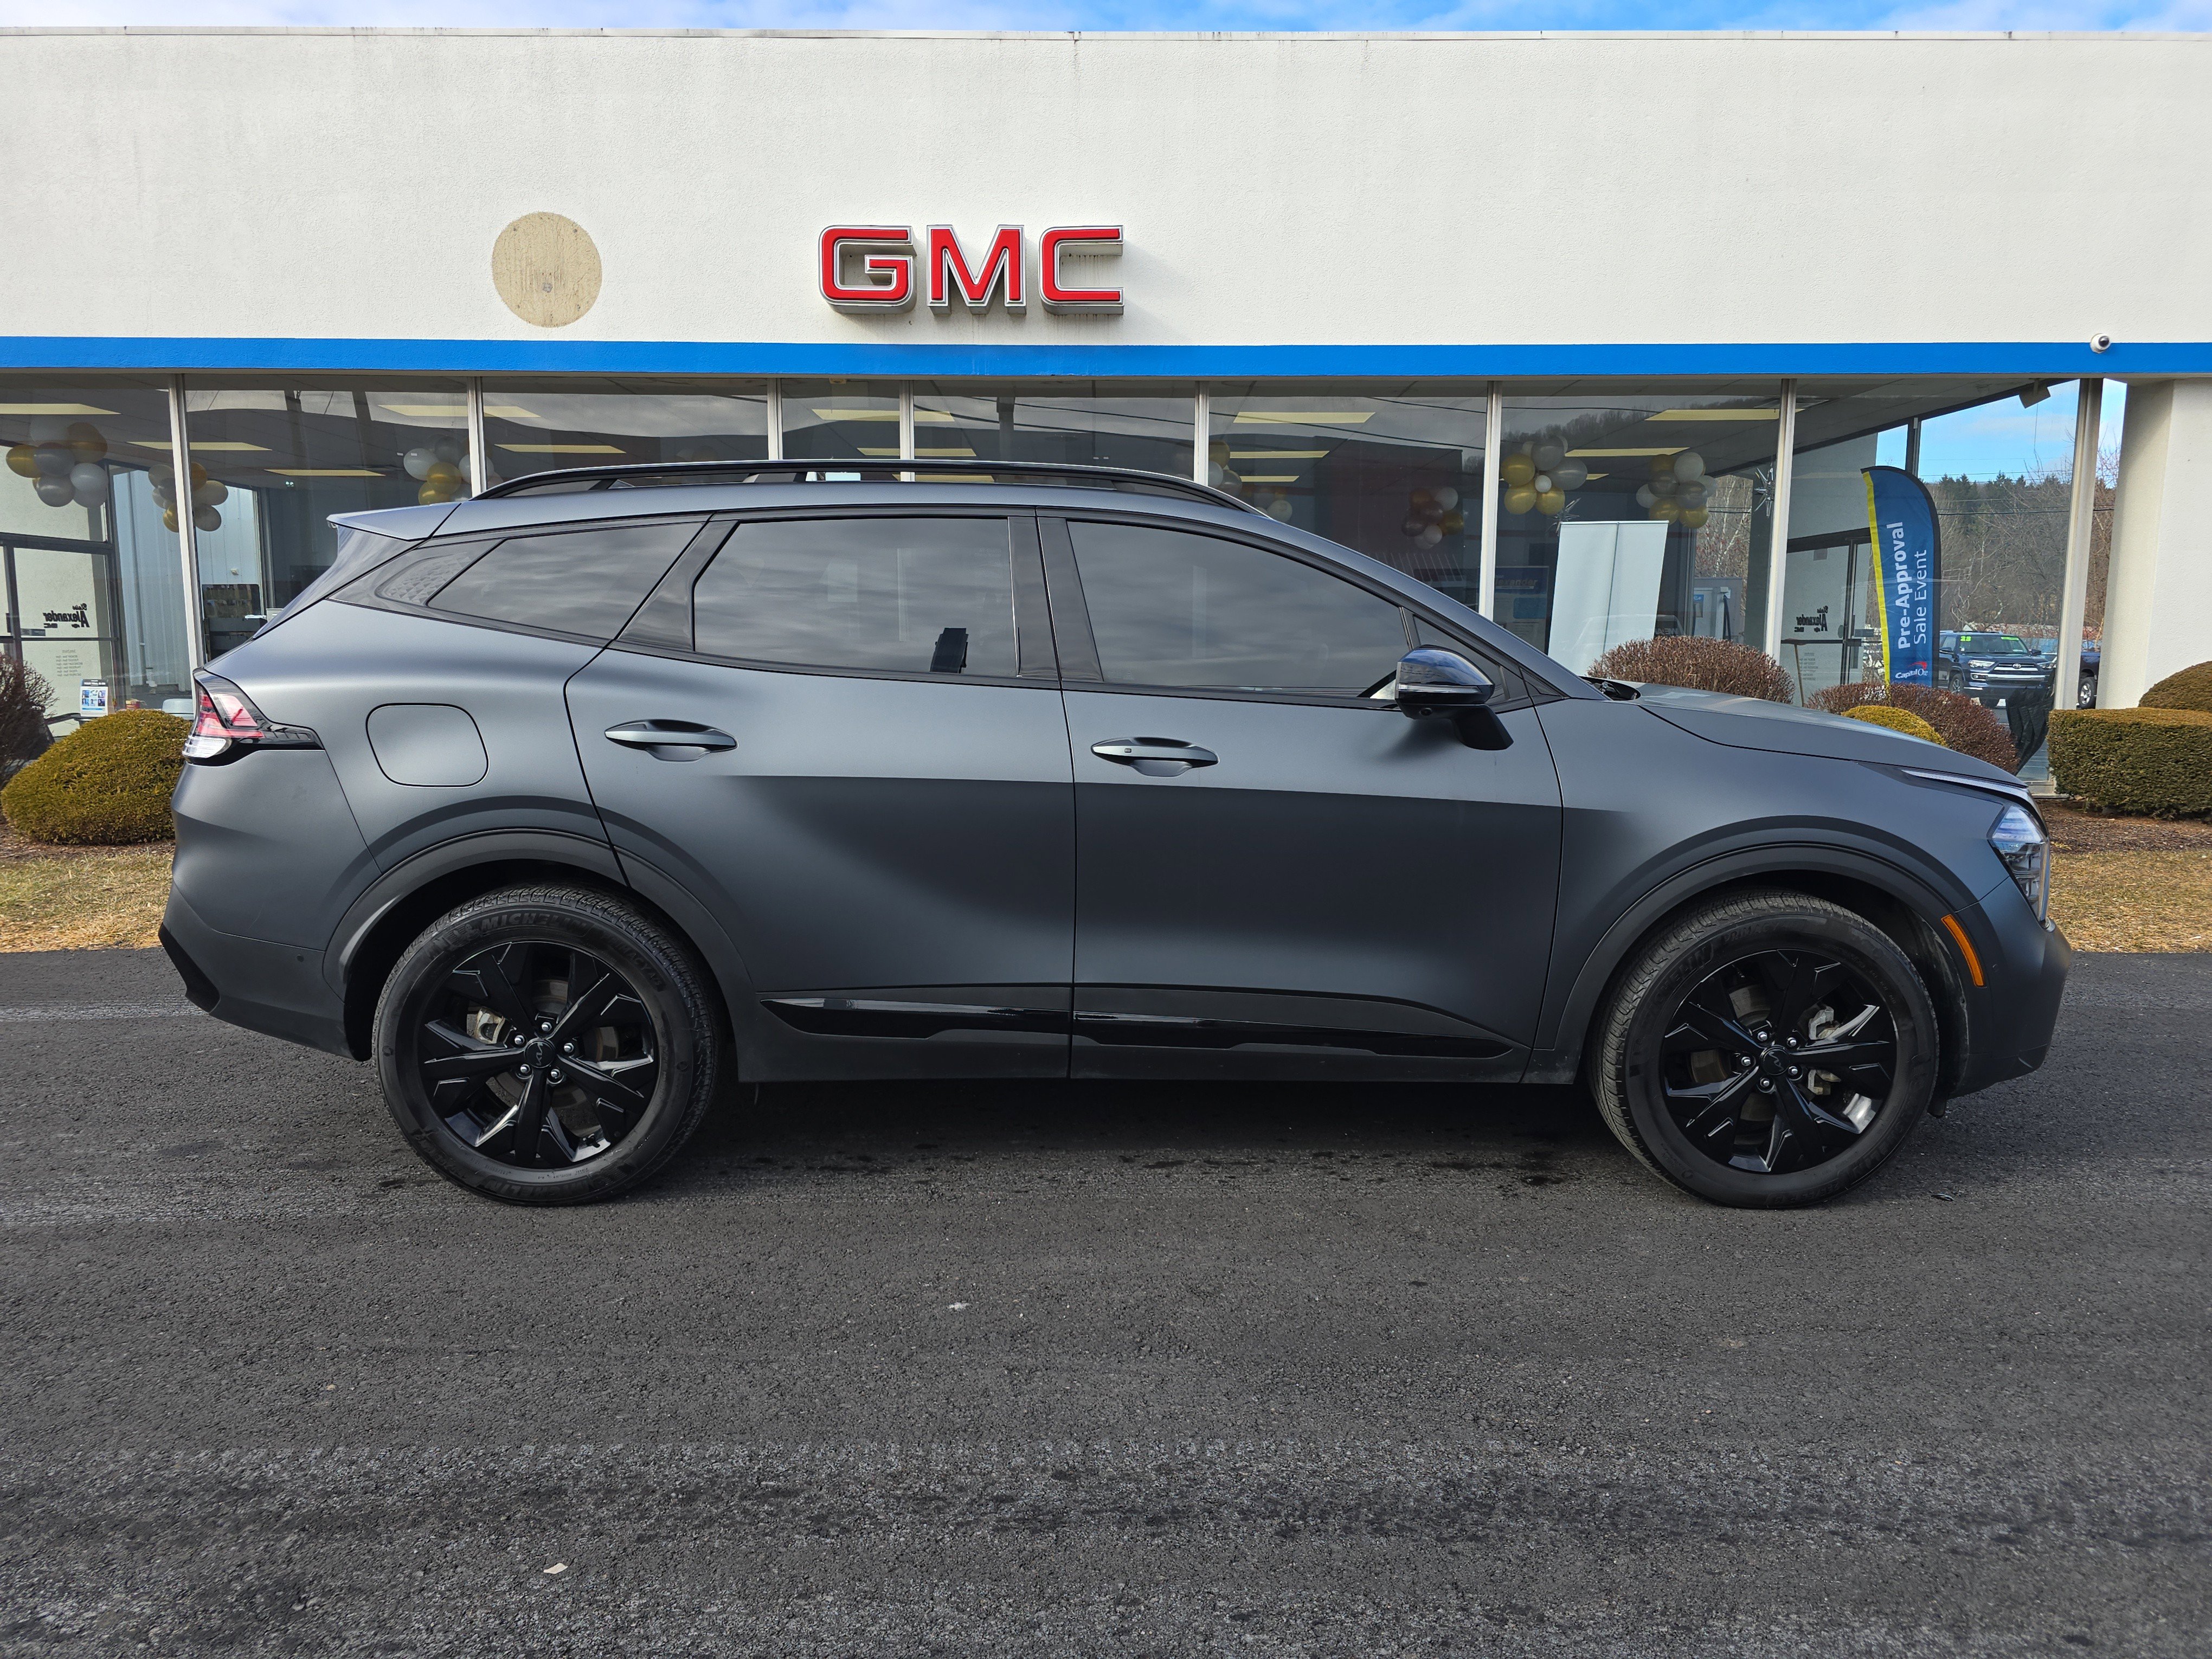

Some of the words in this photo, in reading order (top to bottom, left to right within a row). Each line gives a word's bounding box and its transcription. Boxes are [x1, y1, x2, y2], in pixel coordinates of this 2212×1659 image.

[819, 224, 1124, 314] GMC
[1886, 522, 1913, 650] Pre-Approval
[1914, 550, 1927, 600] Event
[1914, 607, 1927, 644] Sale
[481, 913, 586, 933] MICHELIN
